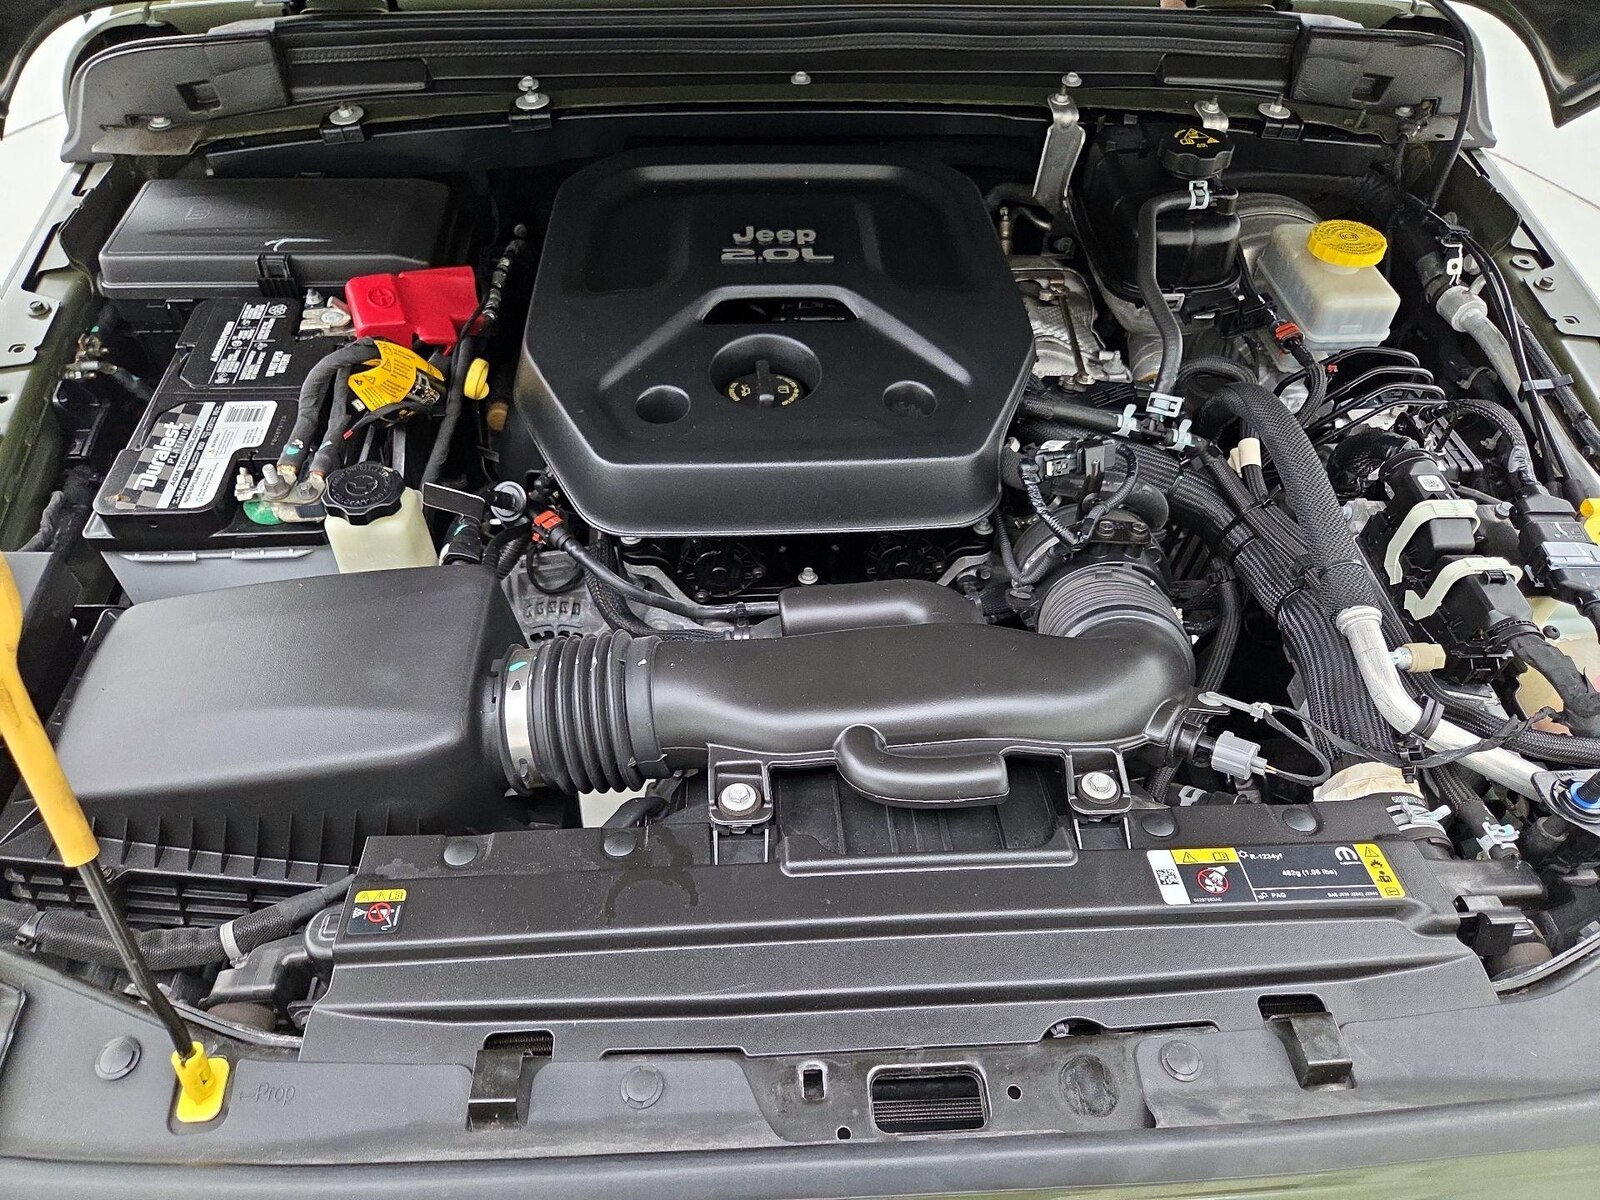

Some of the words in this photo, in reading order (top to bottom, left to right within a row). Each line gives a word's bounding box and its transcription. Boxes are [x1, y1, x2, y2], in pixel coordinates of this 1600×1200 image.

[732, 225, 817, 244] Jeep
[721, 248, 834, 263] 2.0L
[133, 421, 183, 491] Duralast
[167, 421, 193, 464] PLATINUM
[170, 470, 182, 487] AGM
[178, 424, 202, 468] TECHNOLOGY
[256, 1081, 296, 1107] Prop
